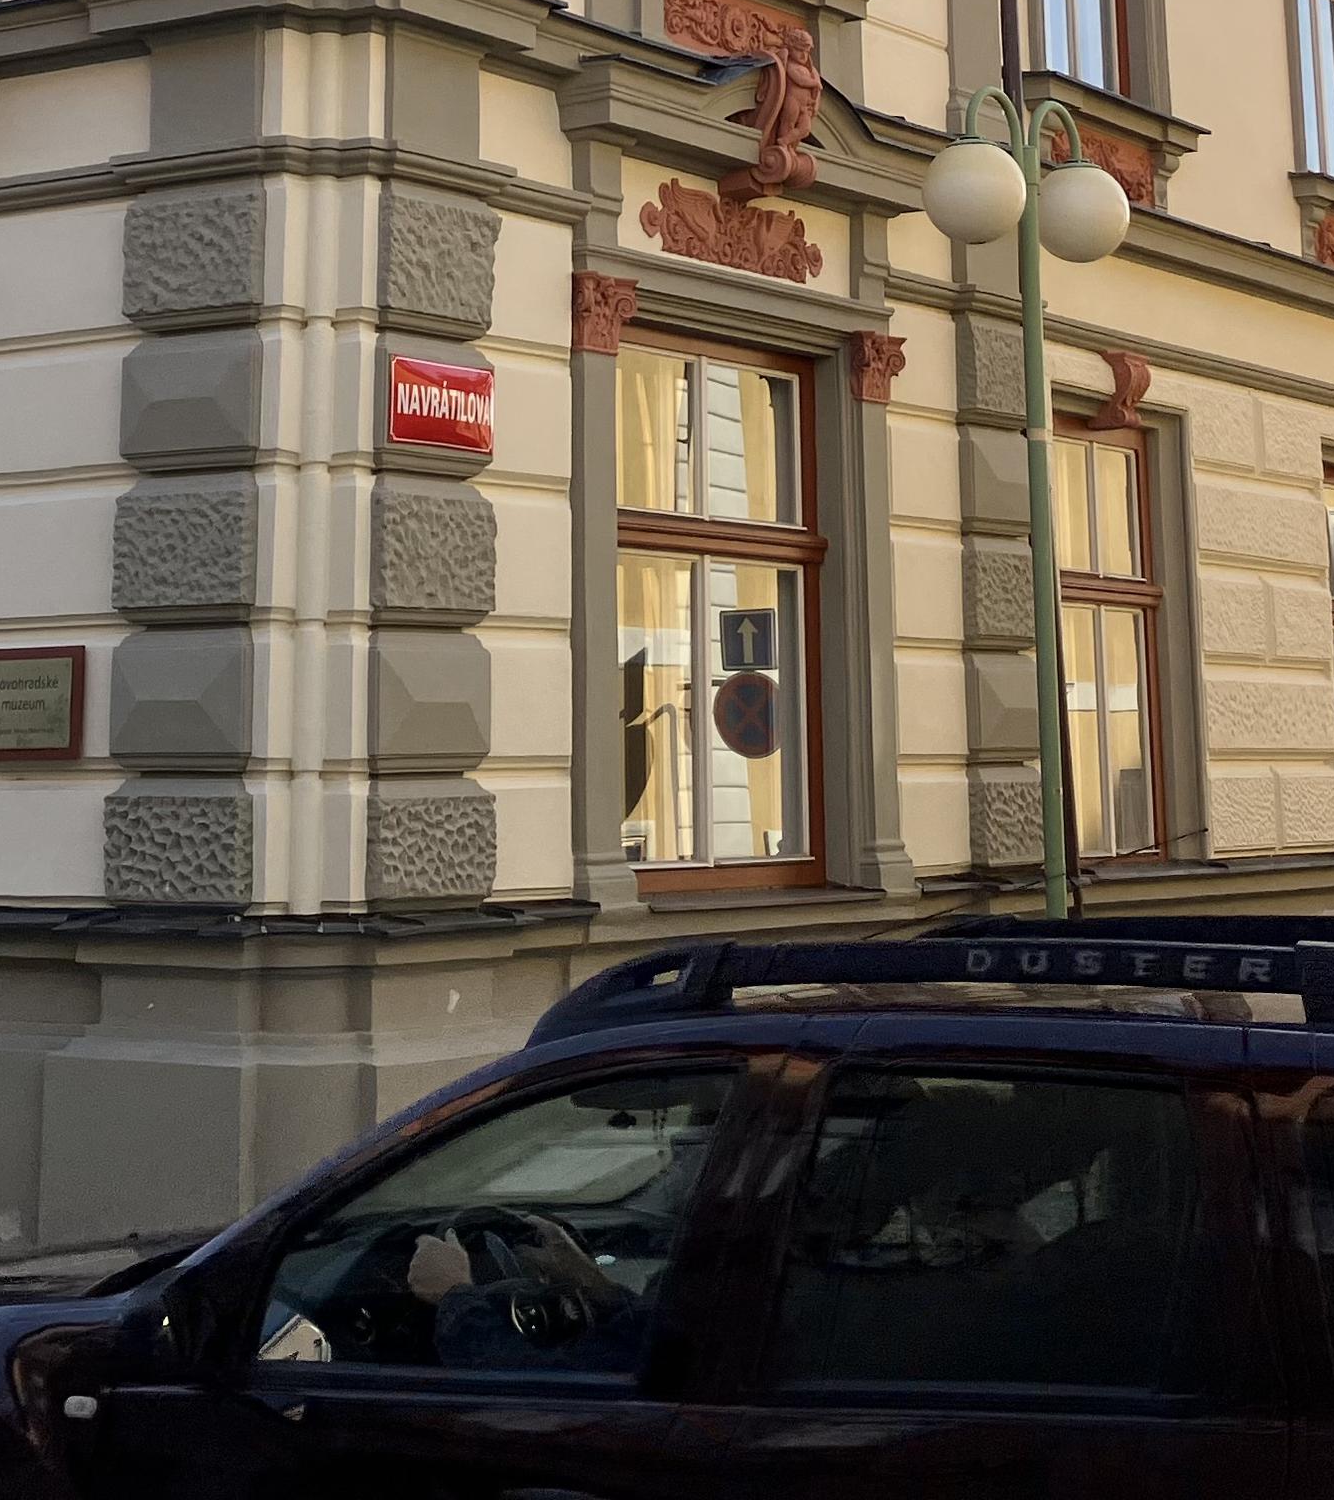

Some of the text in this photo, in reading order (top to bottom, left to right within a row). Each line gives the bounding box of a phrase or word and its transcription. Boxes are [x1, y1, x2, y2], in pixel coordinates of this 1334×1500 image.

[397, 380, 491, 426] NAVRÁTILOVA
[1, 699, 45, 711] muzeum
[967, 948, 1272, 983] DUSTER
